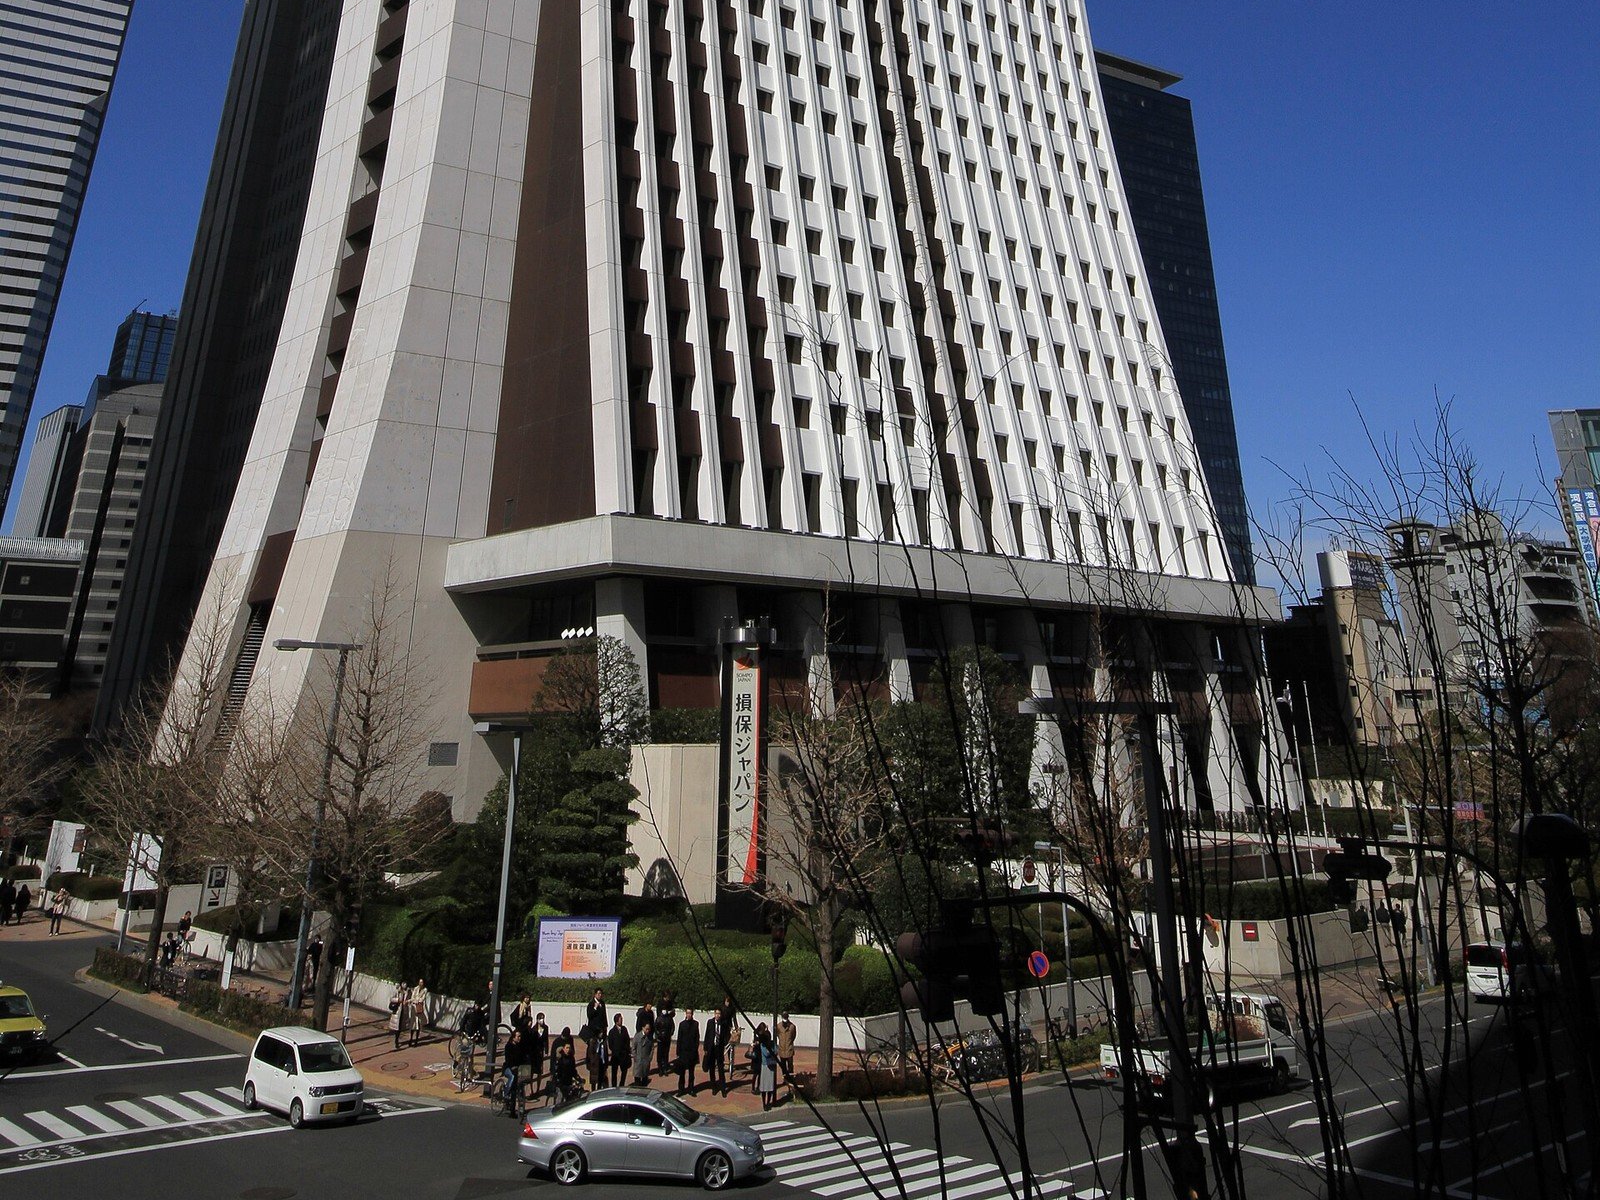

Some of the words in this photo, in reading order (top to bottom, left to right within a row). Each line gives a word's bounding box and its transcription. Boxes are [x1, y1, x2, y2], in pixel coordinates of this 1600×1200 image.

[1569, 493, 1587, 522] 河合塾
[1584, 492, 1599, 516] 河合塾
[734, 693, 752, 812] 損保ジャパン
[211, 868, 225, 887] P
